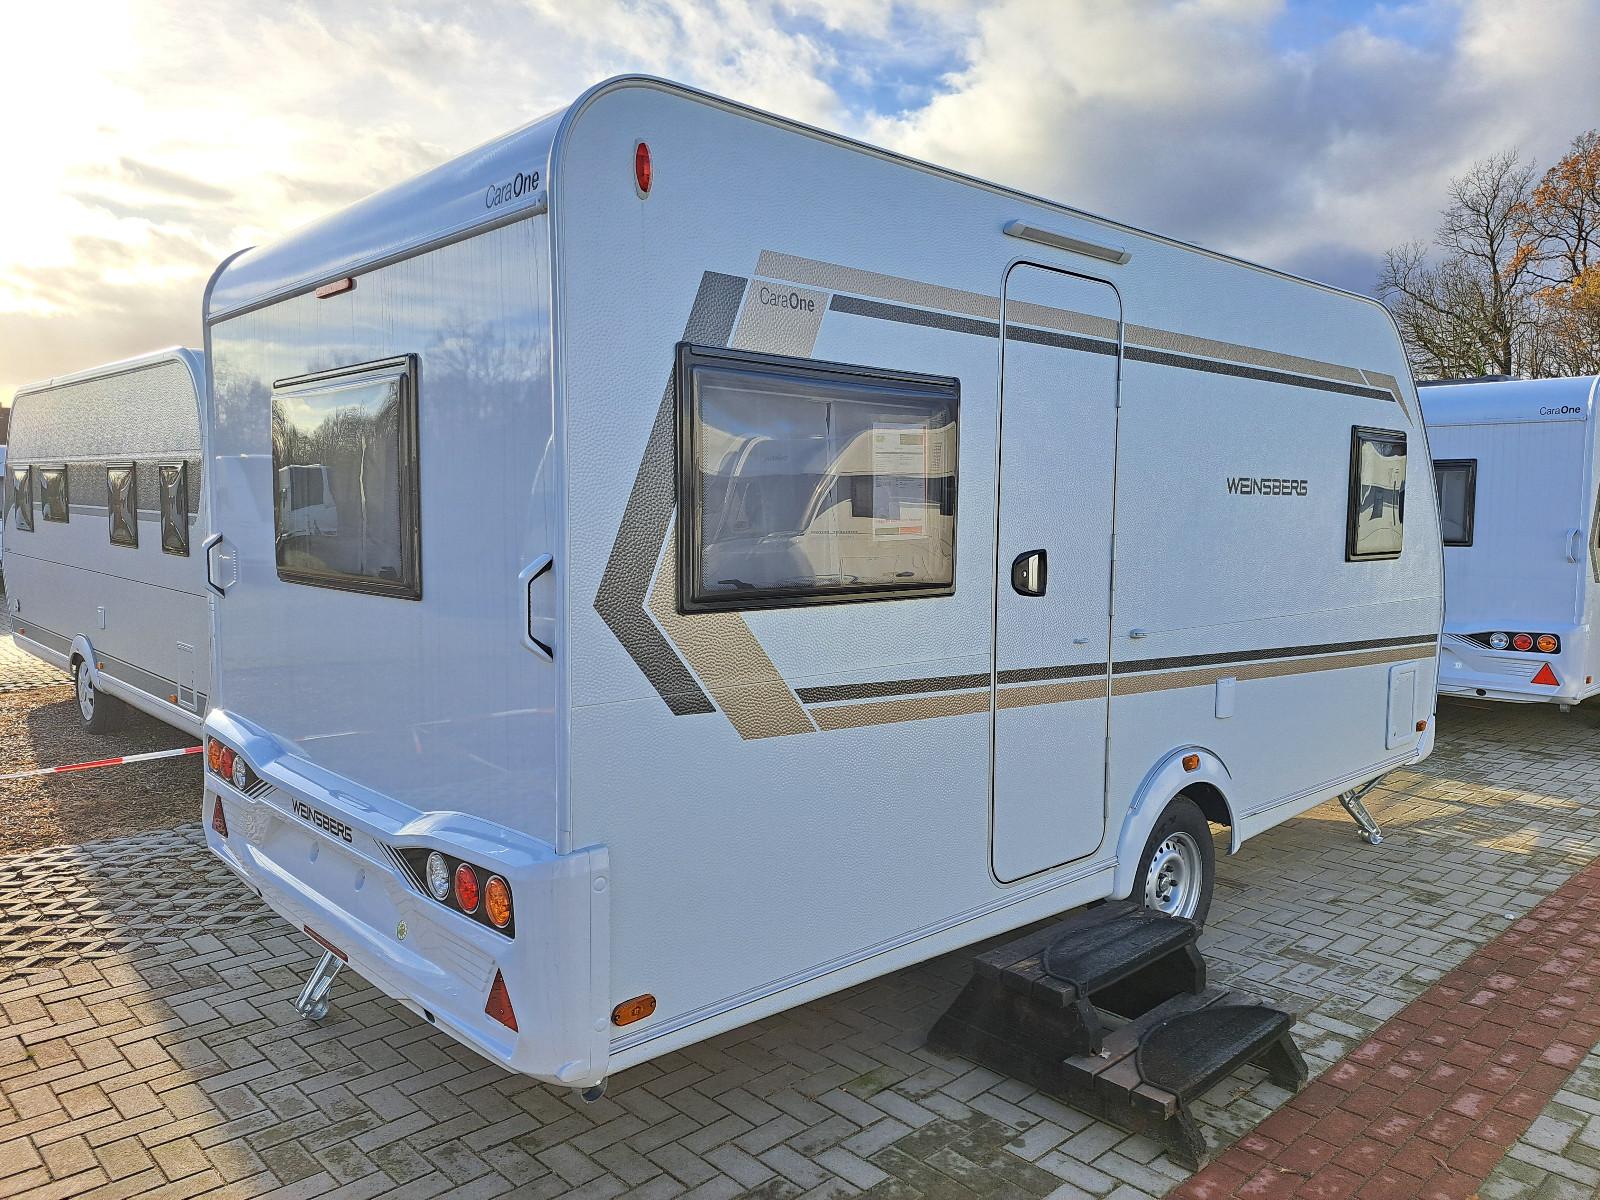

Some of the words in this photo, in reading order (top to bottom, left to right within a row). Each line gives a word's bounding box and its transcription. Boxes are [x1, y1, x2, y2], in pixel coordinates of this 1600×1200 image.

[485, 171, 540, 209] CaraOne
[760, 286, 815, 312] CaraOne
[1539, 405, 1581, 416] CaraOne
[1226, 477, 1308, 496] WEINSBERG
[291, 798, 353, 843] WEINSBERG
